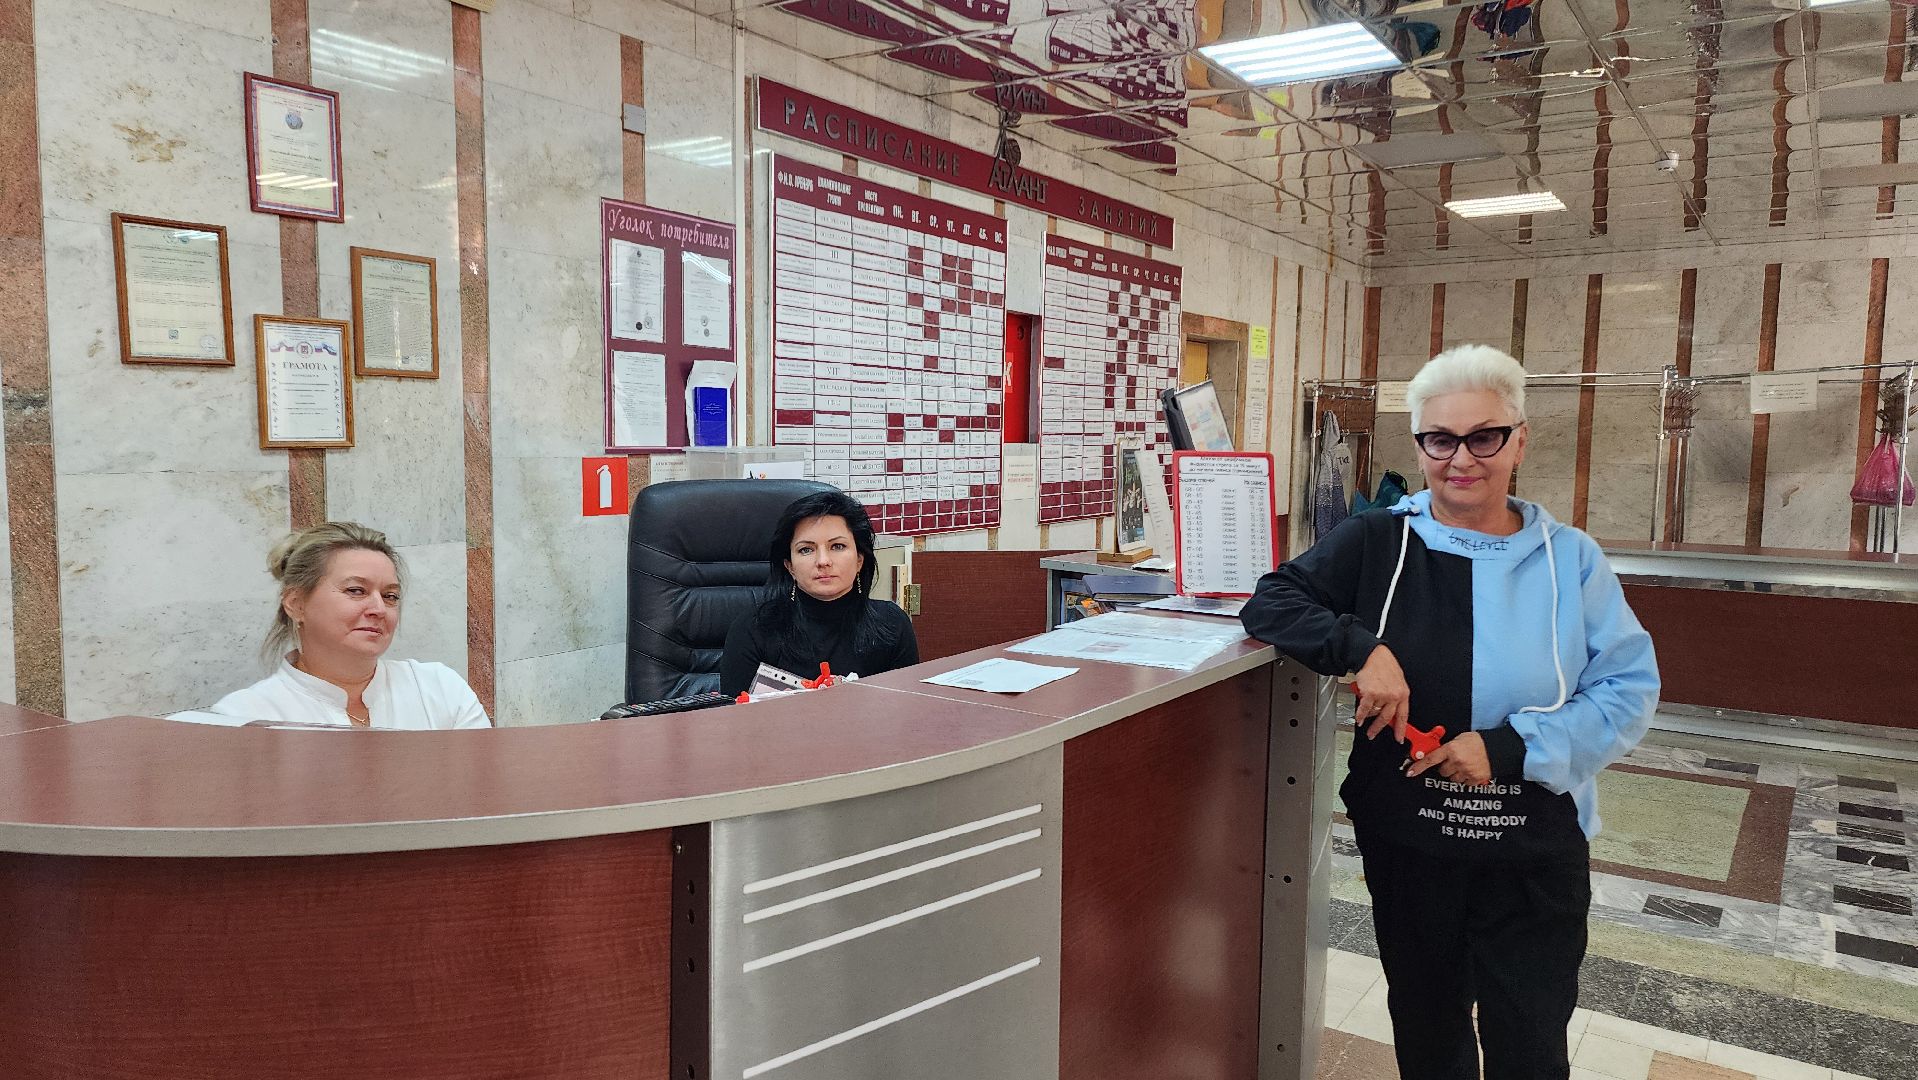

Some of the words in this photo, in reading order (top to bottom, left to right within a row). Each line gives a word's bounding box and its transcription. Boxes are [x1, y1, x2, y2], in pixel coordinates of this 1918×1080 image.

[784, 97, 962, 178] РАСПИСАНИЕ
[989, 160, 1048, 204] АТЛАНТ
[1078, 196, 1157, 238] ЗАНЯТИЙ
[608, 208, 655, 241] Уголок
[660, 222, 730, 250] потребителя
[929, 214, 939, 229] СР.
[283, 361, 328, 371] ГРАМОТА
[1509, 784, 1522, 795] IS
[1443, 797, 1502, 811] AMAZING
[1418, 807, 1445, 821] AND
[1448, 812, 1528, 826] EVERYBODY
[1442, 825, 1454, 836] IS
[1457, 827, 1504, 841] HAPPY
